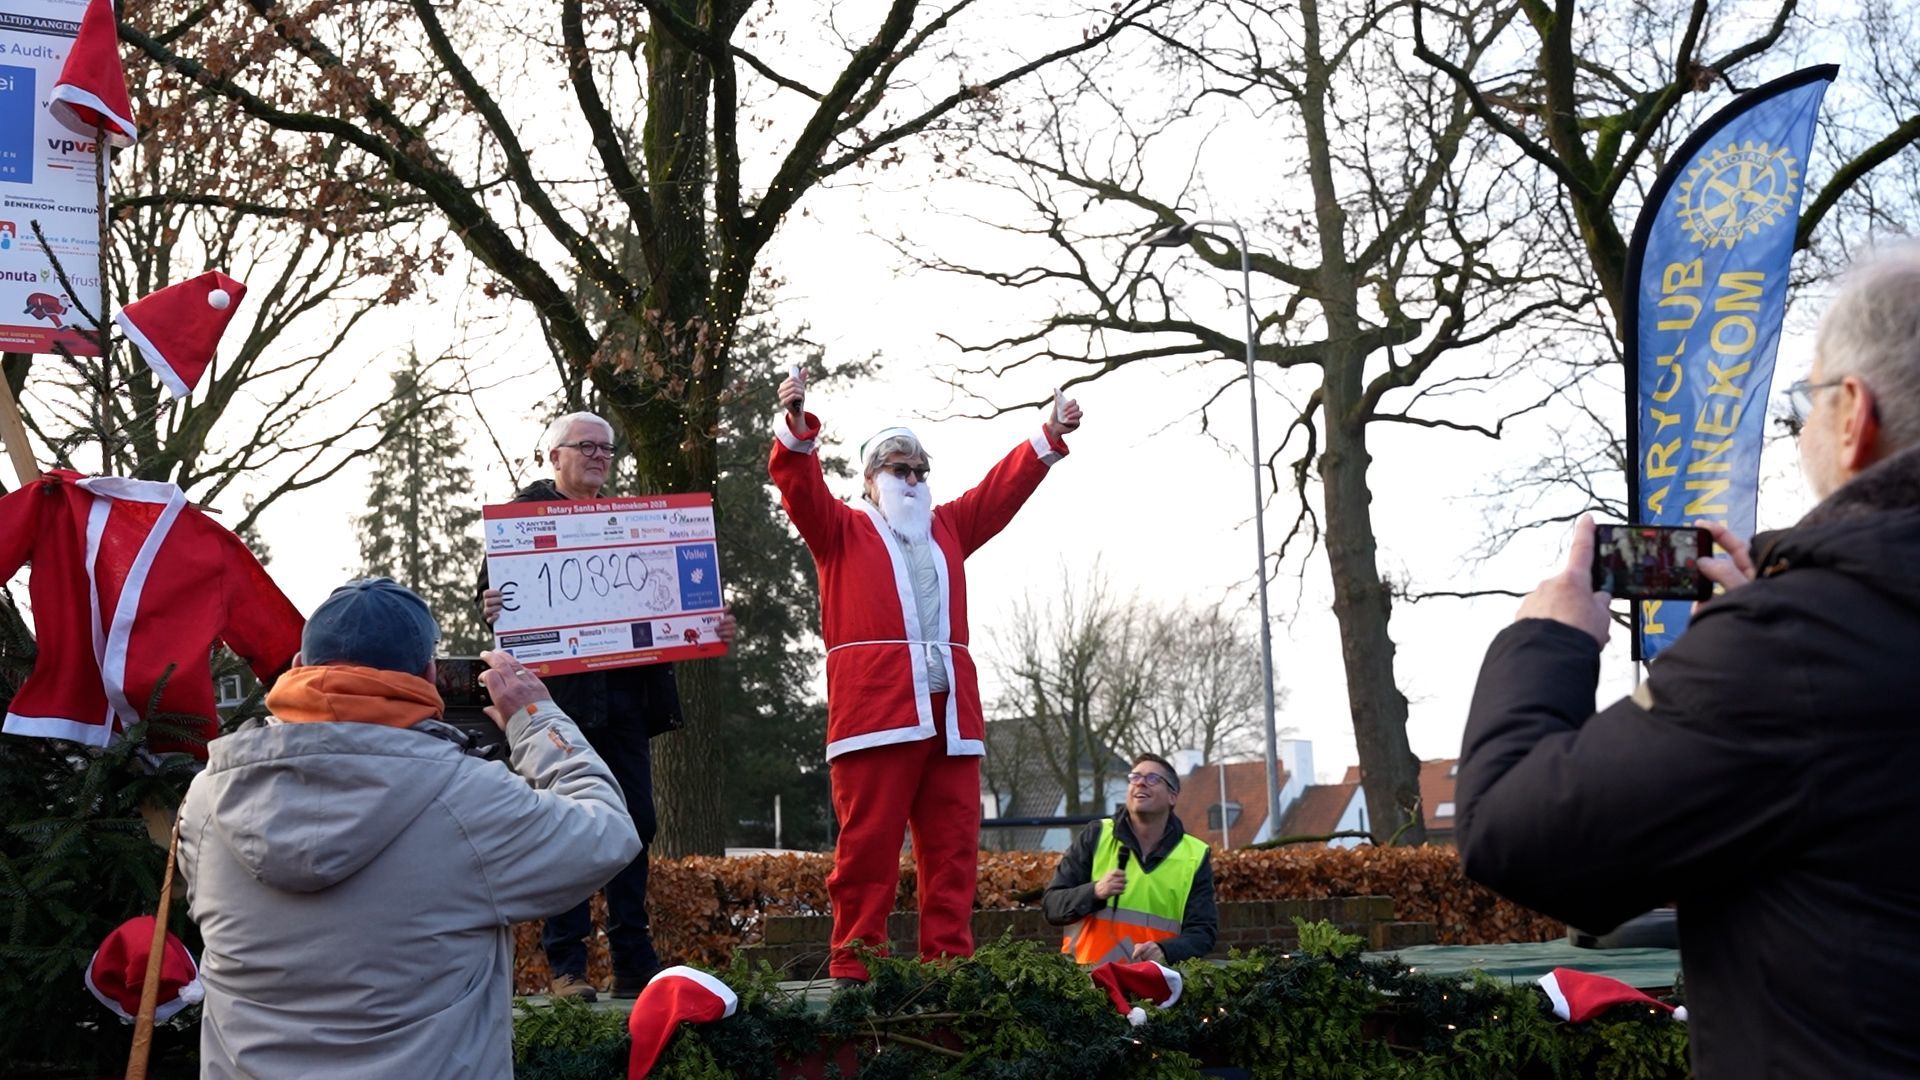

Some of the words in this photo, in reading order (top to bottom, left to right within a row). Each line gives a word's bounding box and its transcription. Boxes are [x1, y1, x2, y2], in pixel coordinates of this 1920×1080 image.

[4, 200, 56, 211] BENNEKOM
[0, 270, 37, 283] onuta
[1684, 271, 1766, 596] NNEKOM
[547, 505, 572, 515] Rotary
[573, 504, 595, 513] Santa
[596, 503, 611, 512] Run
[611, 502, 649, 511] Bennekom
[683, 549, 708, 560] Vallei
[538, 553, 648, 608] 10820
